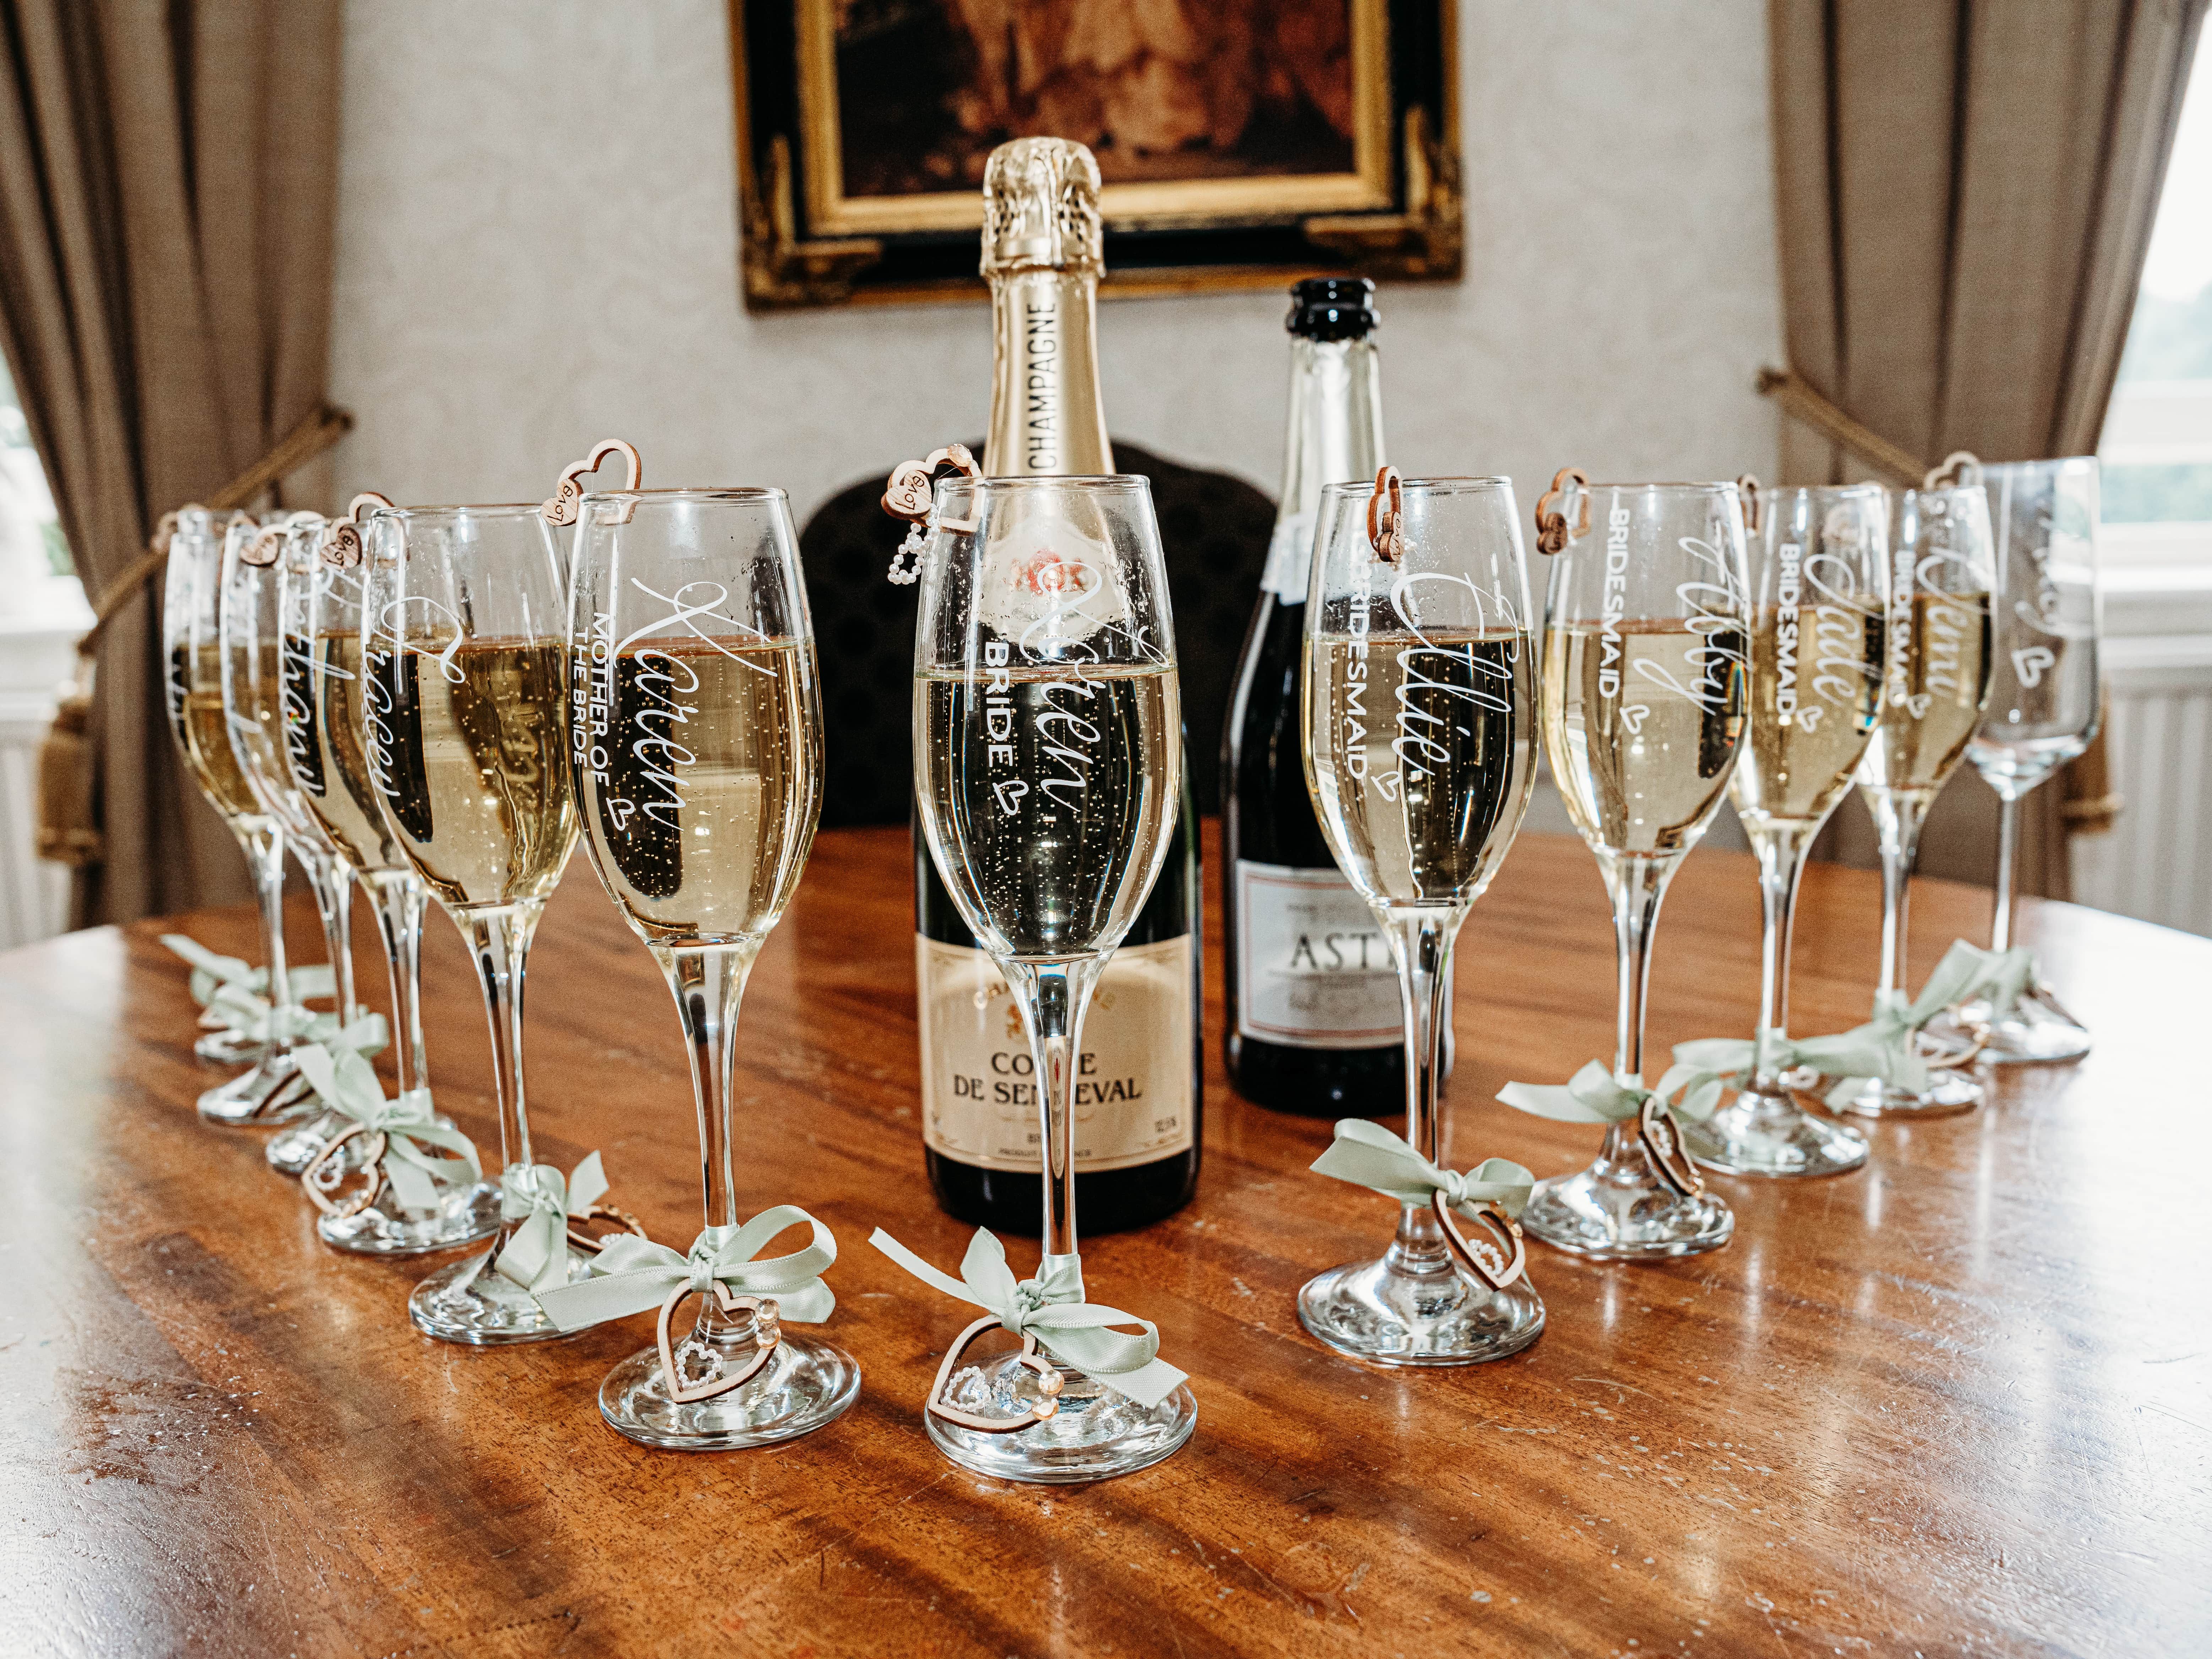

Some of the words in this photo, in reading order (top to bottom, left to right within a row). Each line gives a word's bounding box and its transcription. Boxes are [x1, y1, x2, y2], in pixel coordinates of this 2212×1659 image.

[1028, 303, 1058, 470] CHAMPAGNE
[547, 485, 573, 522] Love
[895, 476, 925, 510] Love
[574, 626, 588, 682] THE
[1599, 508, 1629, 698] BRIDESMAID
[1776, 543, 1801, 715] BRIDESMAID
[573, 689, 588, 768] BRIDE
[589, 612, 610, 737] MOTHER
[613, 577, 778, 831] Karen
[985, 642, 1012, 768] BRIDE
[1346, 561, 1370, 779] BRIDESMAID
[1390, 572, 1519, 776] Ellie
[589, 745, 610, 787] OF
[953, 1074, 985, 1101] DE
[991, 1051, 1097, 1076] COE
